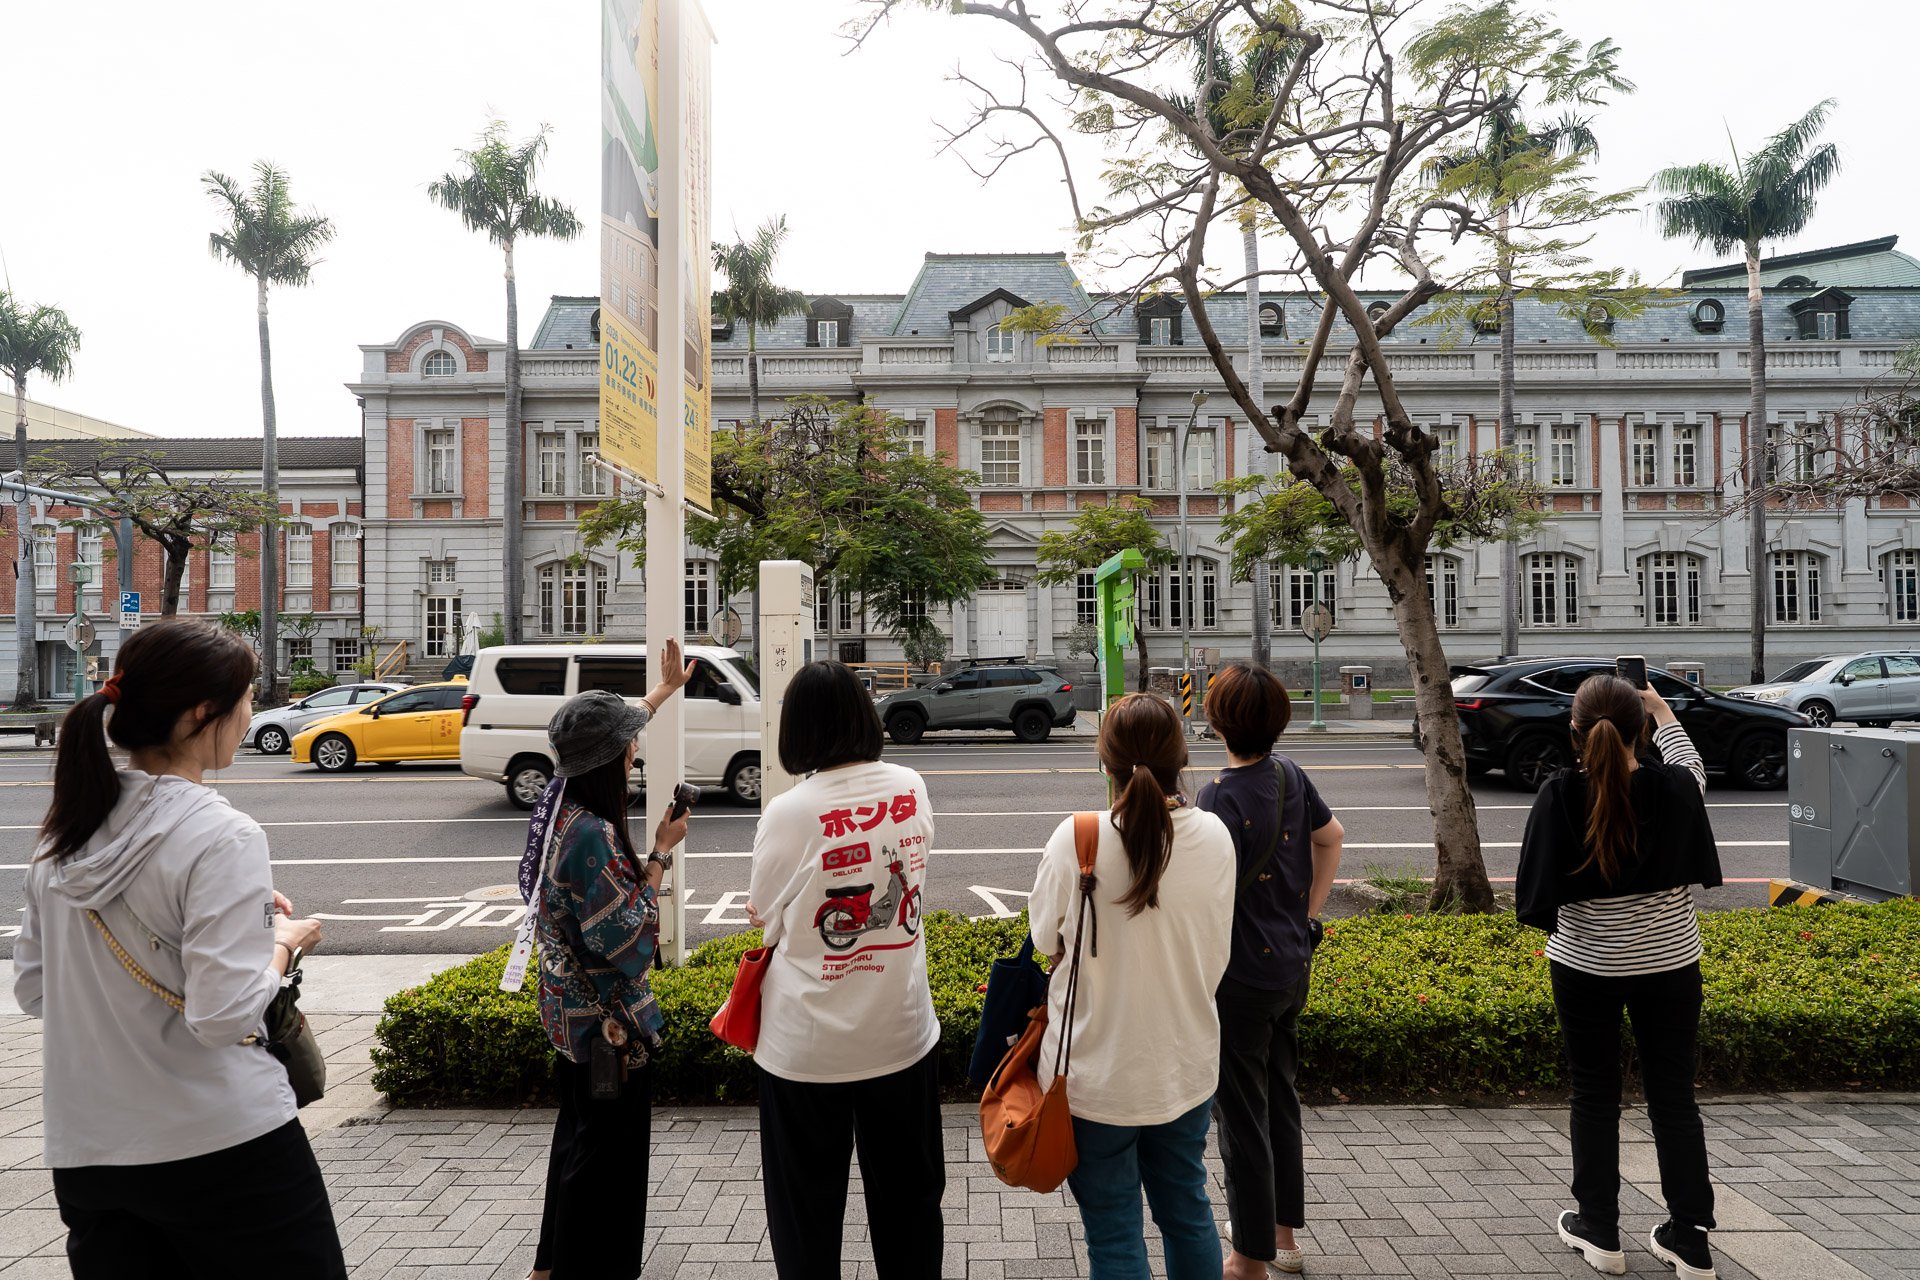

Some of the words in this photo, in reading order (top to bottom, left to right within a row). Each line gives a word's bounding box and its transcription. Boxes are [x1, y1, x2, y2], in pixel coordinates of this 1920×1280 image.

[605, 341, 637, 388] 01.22
[122, 593, 131, 603] P
[819, 789, 917, 838] ホンダ
[826, 853, 840, 865] C
[843, 847, 867, 863] 70
[832, 867, 863, 878] DELUXE
[821, 974, 844, 982] Japan
